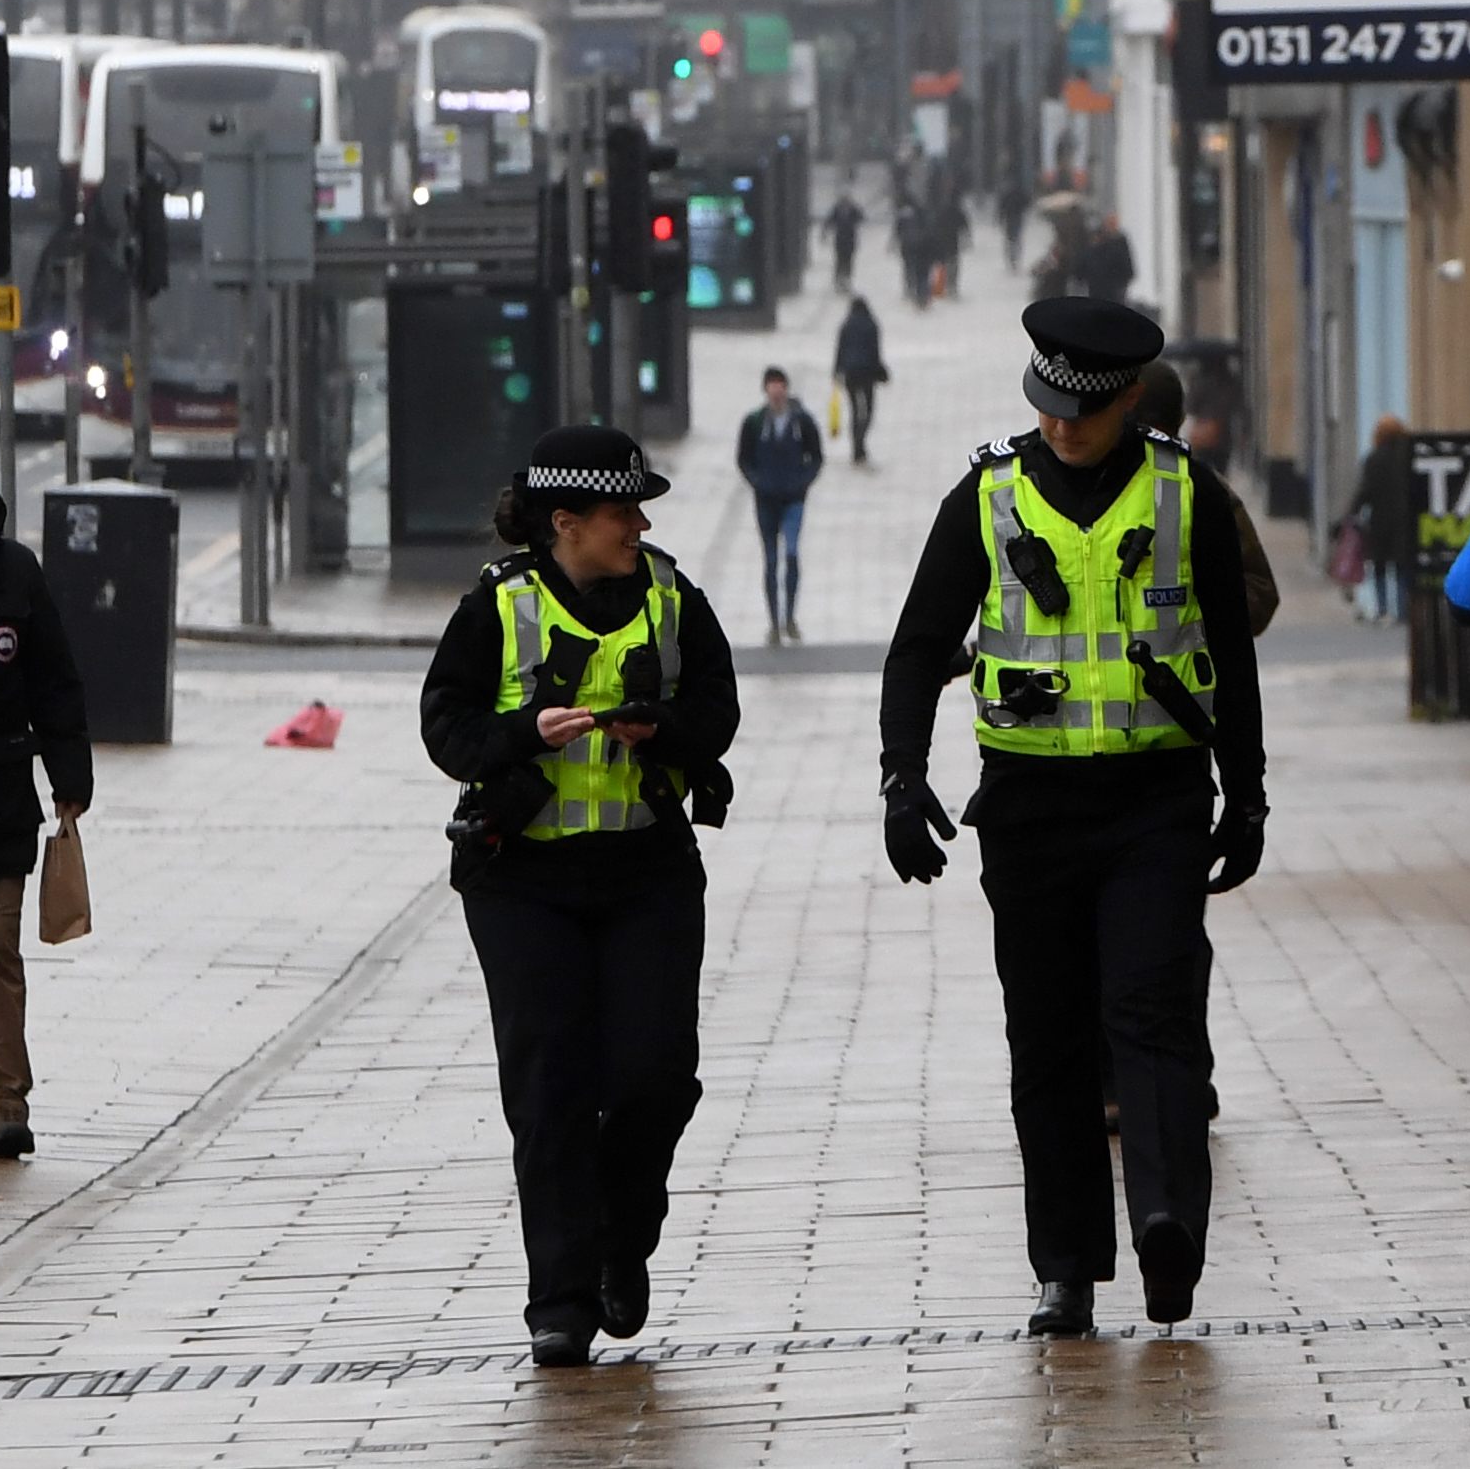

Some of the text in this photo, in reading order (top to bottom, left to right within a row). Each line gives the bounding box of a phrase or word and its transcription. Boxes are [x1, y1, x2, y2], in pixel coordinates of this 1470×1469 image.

[1217, 25, 1311, 68] 0131
[1321, 22, 1406, 64] 247
[1145, 589, 1186, 605] POLICE
